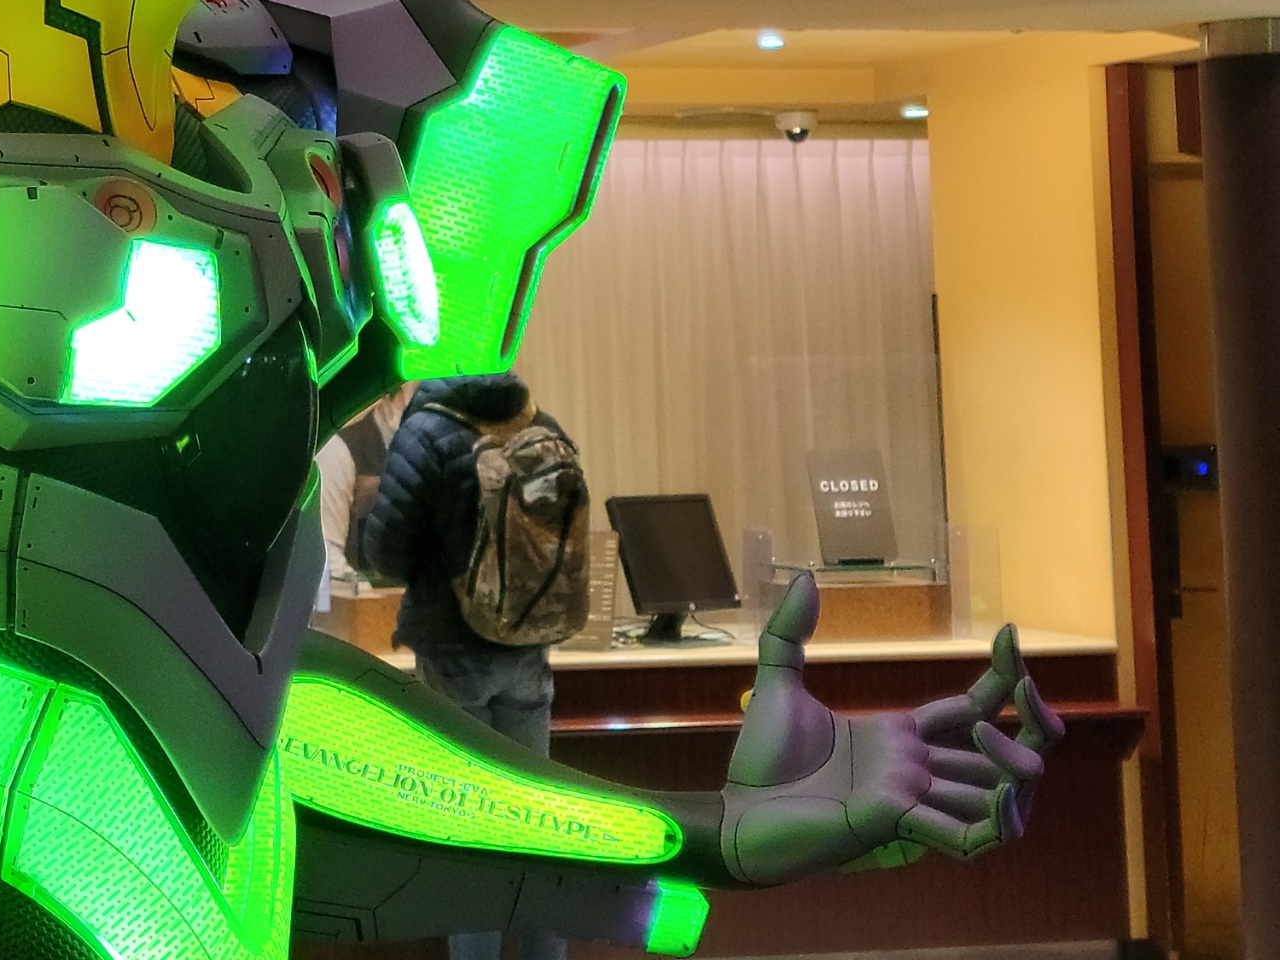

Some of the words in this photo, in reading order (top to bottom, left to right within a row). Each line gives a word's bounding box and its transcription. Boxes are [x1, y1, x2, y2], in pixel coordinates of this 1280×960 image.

[820, 479, 879, 493] CLOSED
[397, 791, 426, 805] NERV
[431, 801, 476, 819] TOKYO-3
